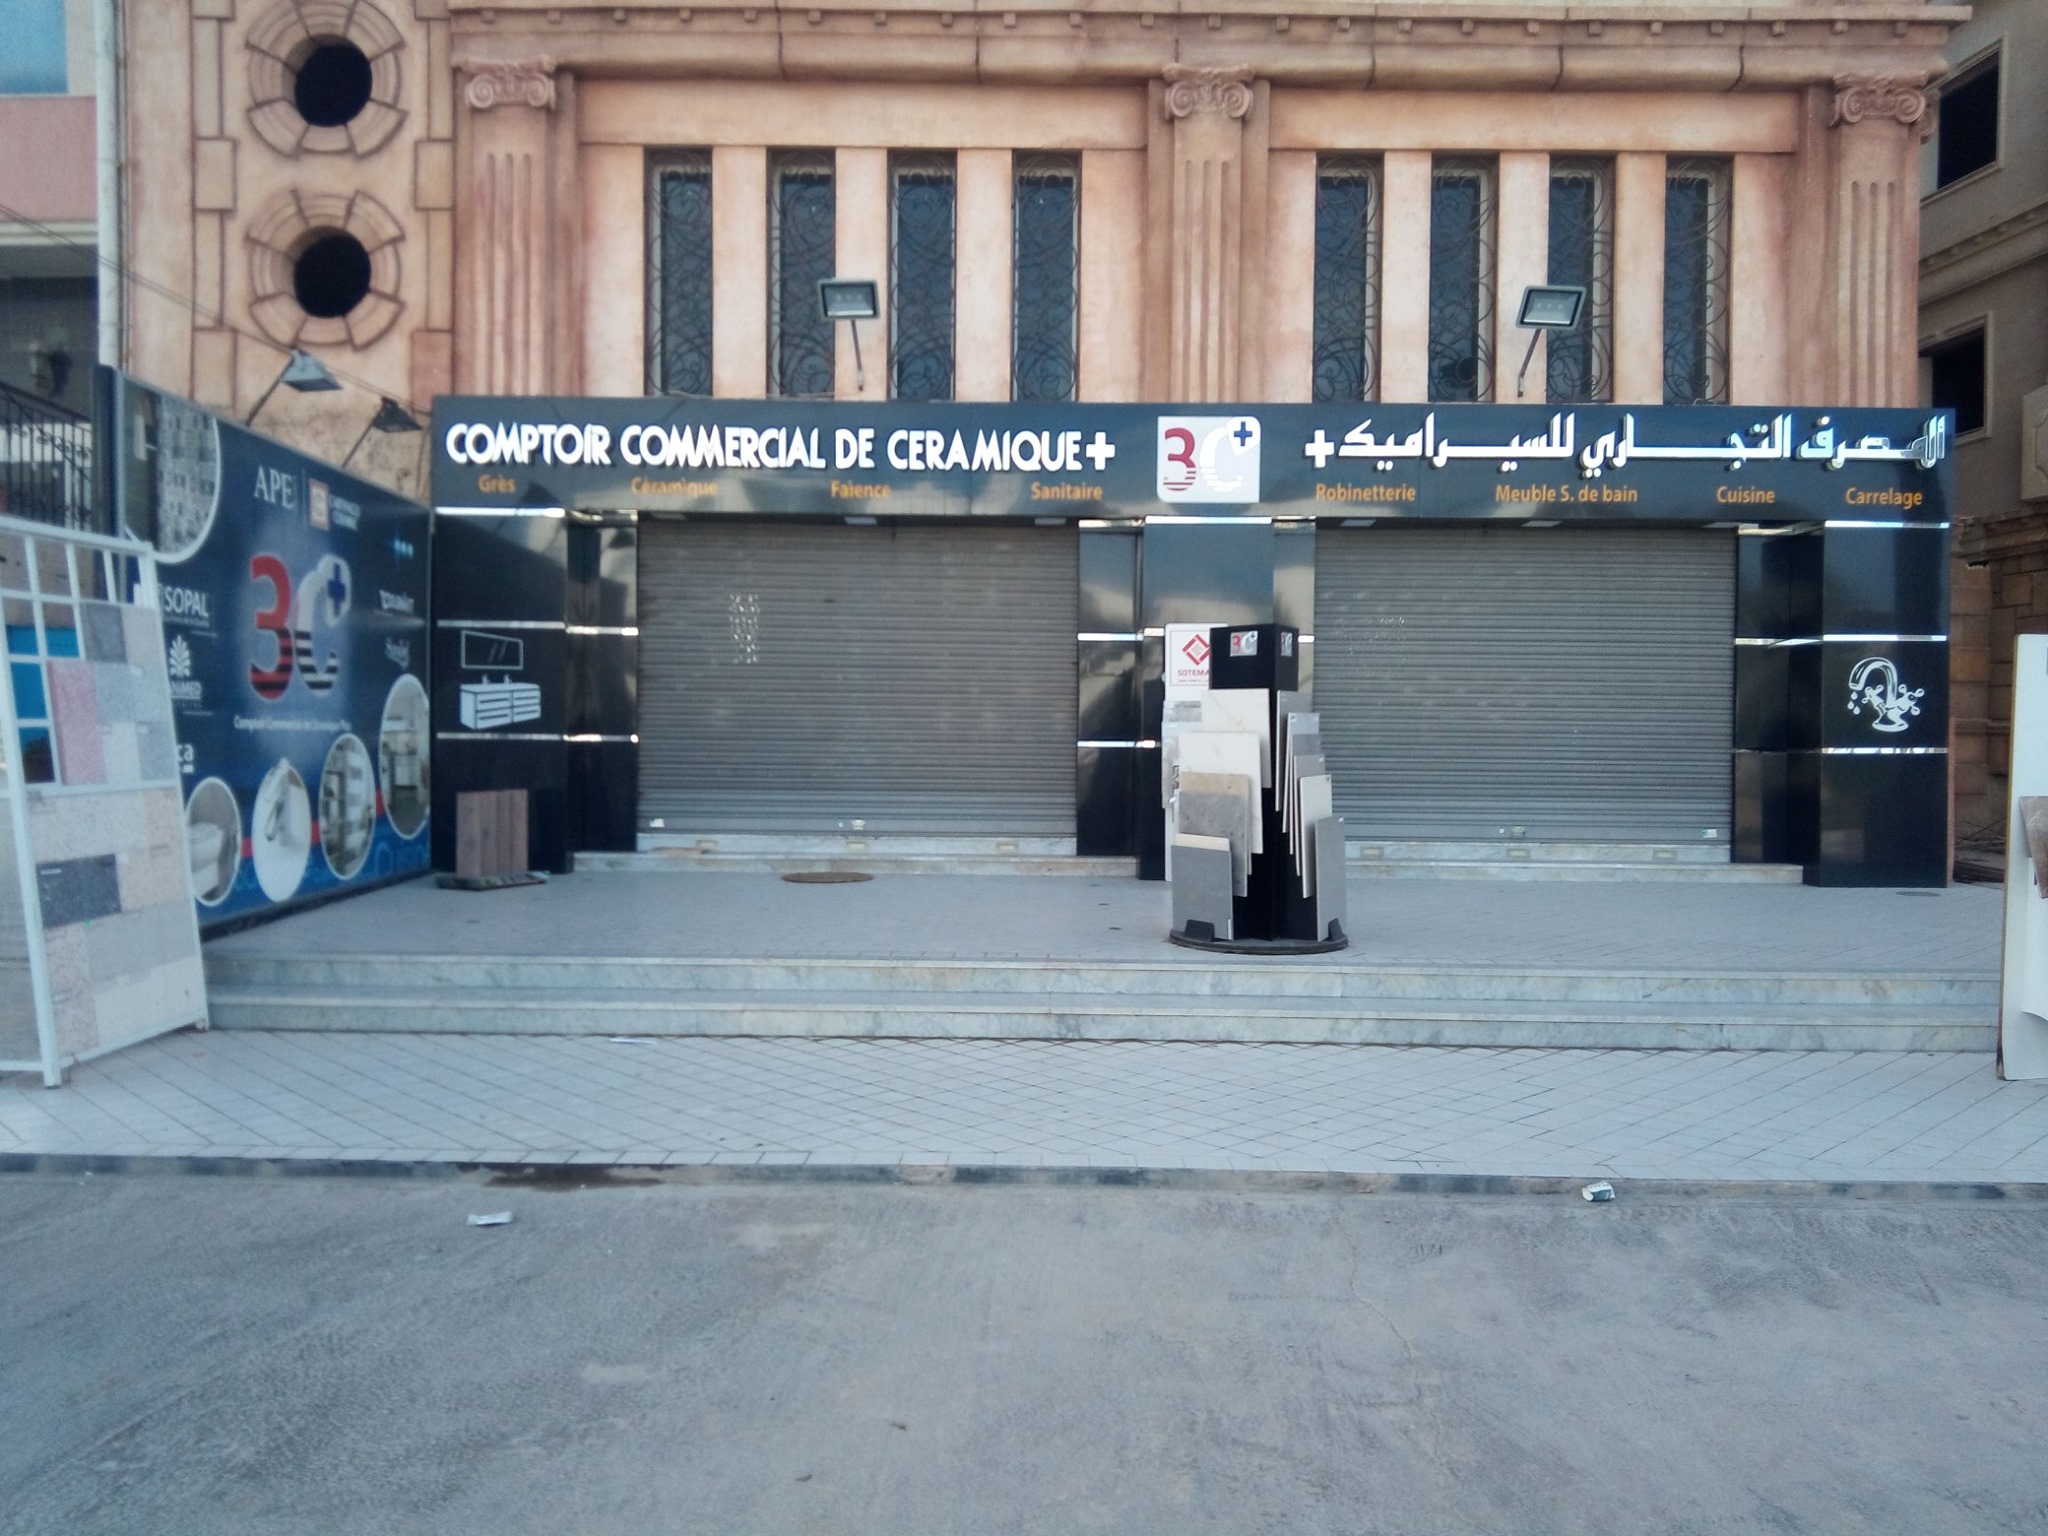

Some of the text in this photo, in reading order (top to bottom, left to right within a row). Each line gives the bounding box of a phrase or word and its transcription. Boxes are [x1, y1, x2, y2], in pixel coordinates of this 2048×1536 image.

[446, 421, 611, 465] COMPTOIR
[620, 424, 826, 469] COMMERCIAL
[834, 428, 875, 469] DE
[1580, 412, 1793, 479] التجاري
[1798, 414, 1946, 469] المصرف
[478, 474, 516, 493] Grès
[1030, 480, 1103, 501] Sanitaire
[1315, 483, 1417, 501] Robinetterie
[1495, 484, 1638, 502] Meuble S. de bain
[1716, 485, 1776, 504] Cuisine
[1845, 487, 1923, 510] Carrelage
[164, 586, 209, 618] SOPAL
